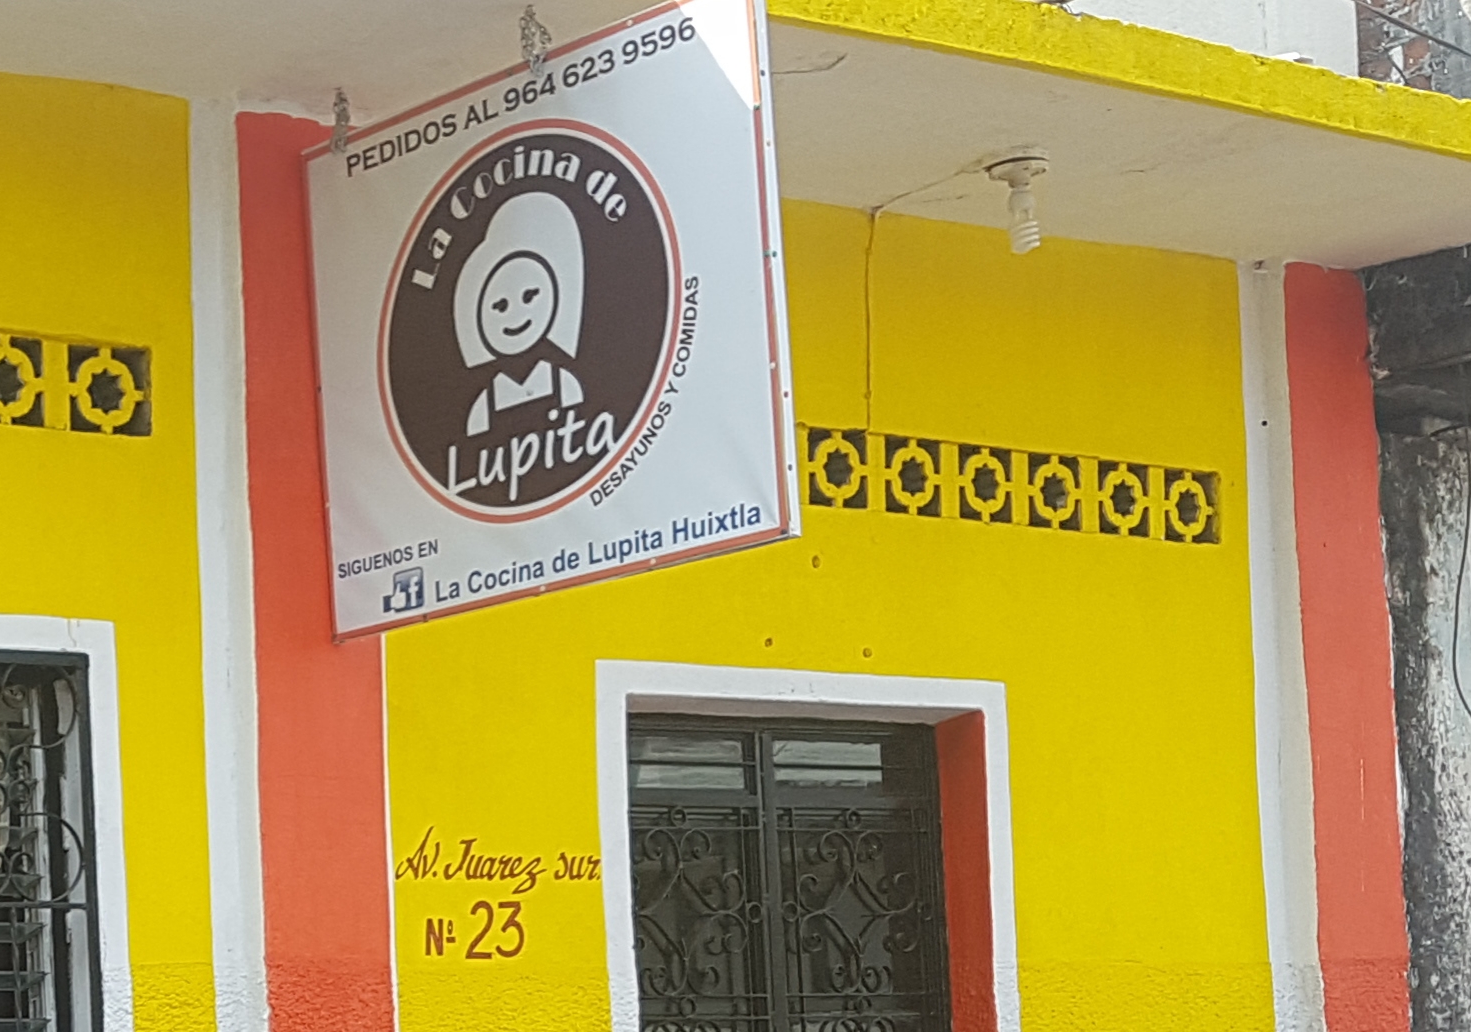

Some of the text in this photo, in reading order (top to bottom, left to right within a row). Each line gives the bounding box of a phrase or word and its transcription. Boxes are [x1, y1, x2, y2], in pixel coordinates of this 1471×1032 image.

[346, 17, 696, 177] PEDIDOS AL 964 623 9596
[411, 145, 628, 290] La Cocina de
[589, 276, 699, 507] DESAYUNOS Y COMIDAS
[448, 409, 616, 502] Lupita
[338, 539, 439, 579] SIGUENOS EN
[435, 503, 762, 603] La Cocina de Lupita Huixtla
[395, 826, 440, 880] Av.
[443, 838, 547, 895] Juarez
[465, 900, 525, 960] 23
